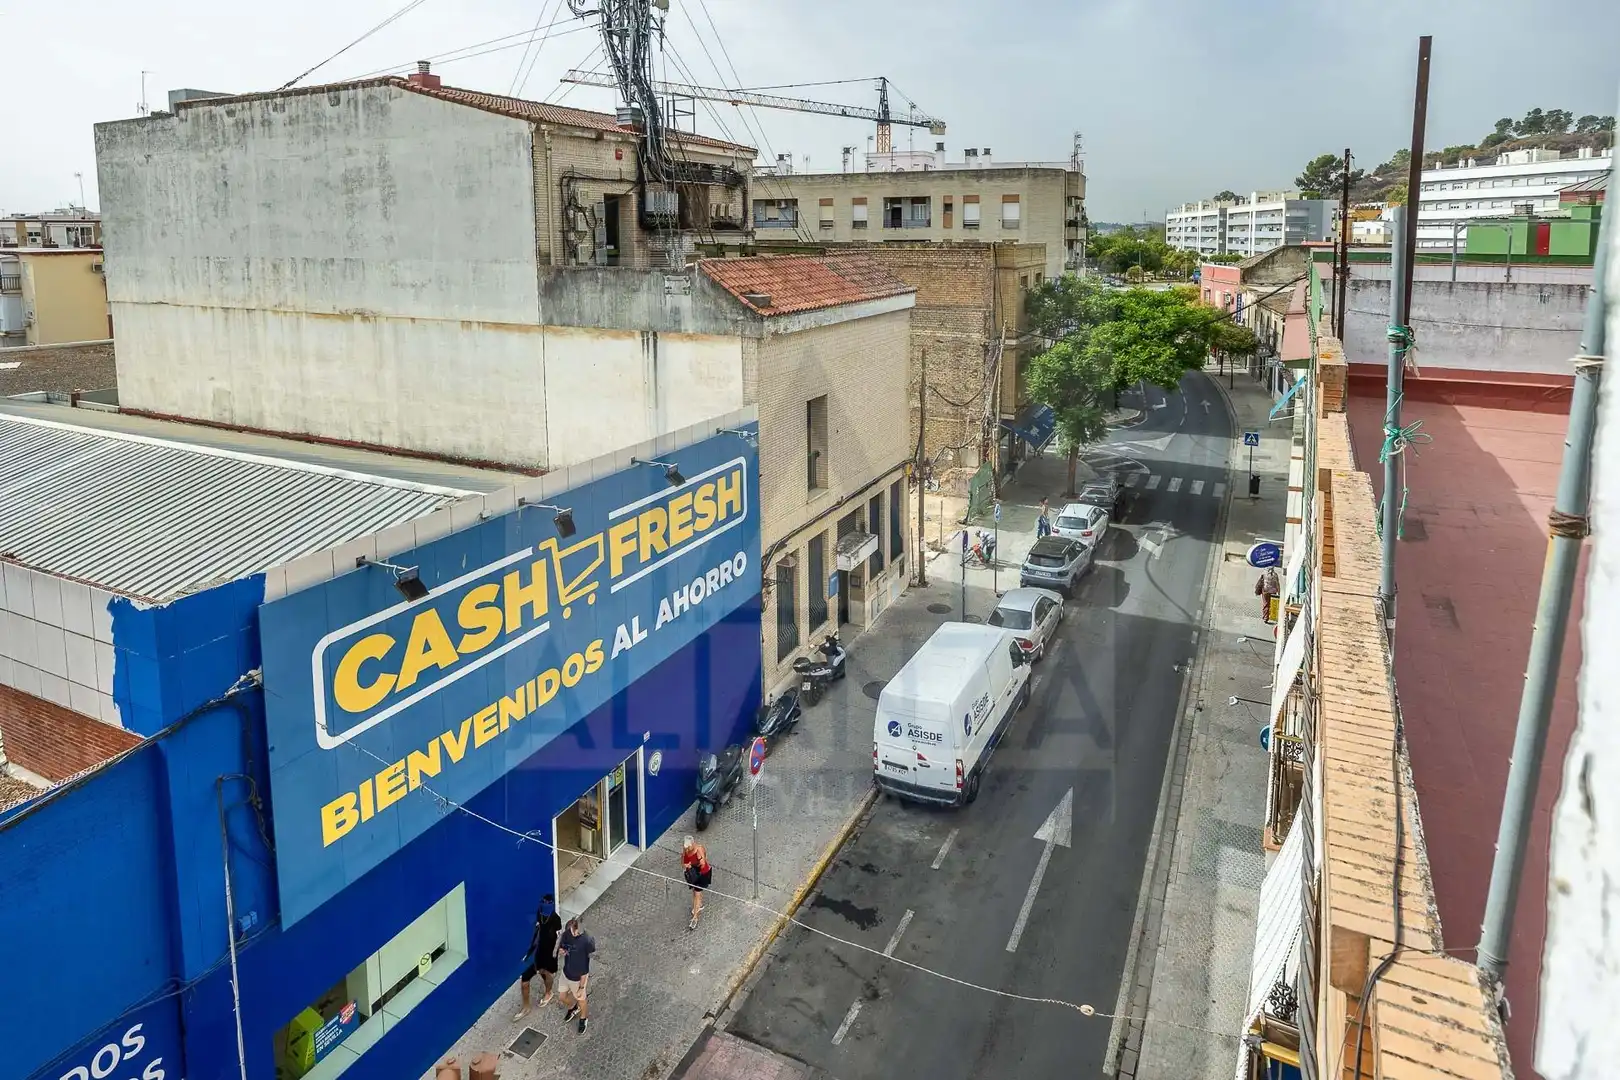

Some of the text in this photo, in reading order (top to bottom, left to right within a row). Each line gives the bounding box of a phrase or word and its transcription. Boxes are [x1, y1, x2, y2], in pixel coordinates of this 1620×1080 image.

[321, 551, 747, 848] BIENVENIDOS AL AHORRO
[334, 470, 741, 713] CASH FRESH
[907, 729, 943, 742] ASISDE
